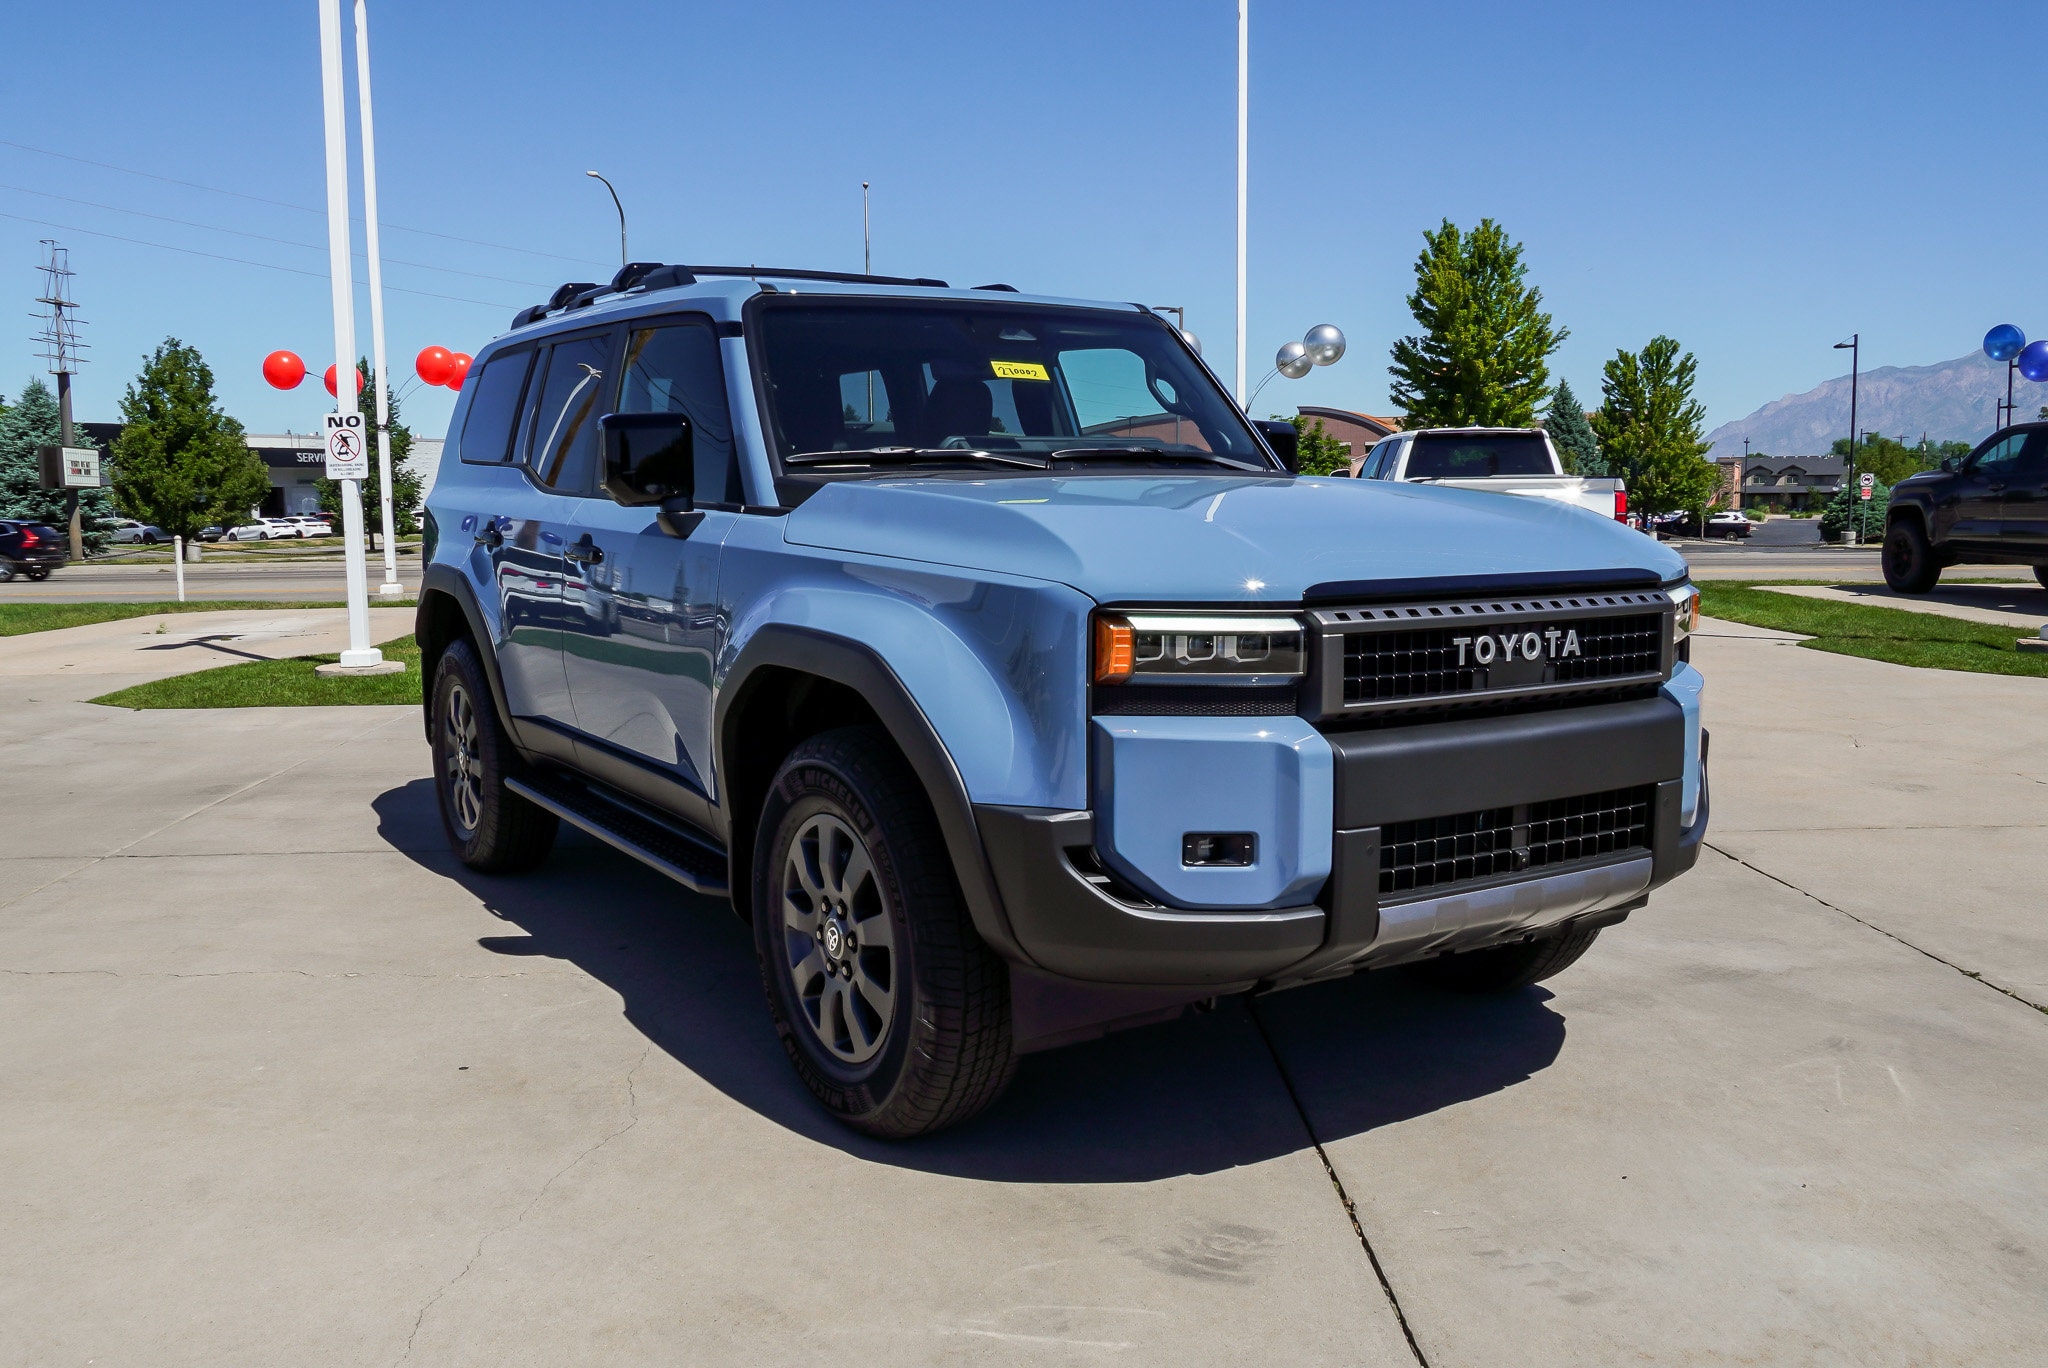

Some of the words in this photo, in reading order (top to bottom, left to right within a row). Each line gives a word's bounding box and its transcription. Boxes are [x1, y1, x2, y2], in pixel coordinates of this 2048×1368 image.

[328, 416, 360, 428] NO
[1453, 629, 1581, 666] TOYOTA
[803, 768, 870, 834] MICHELIN
